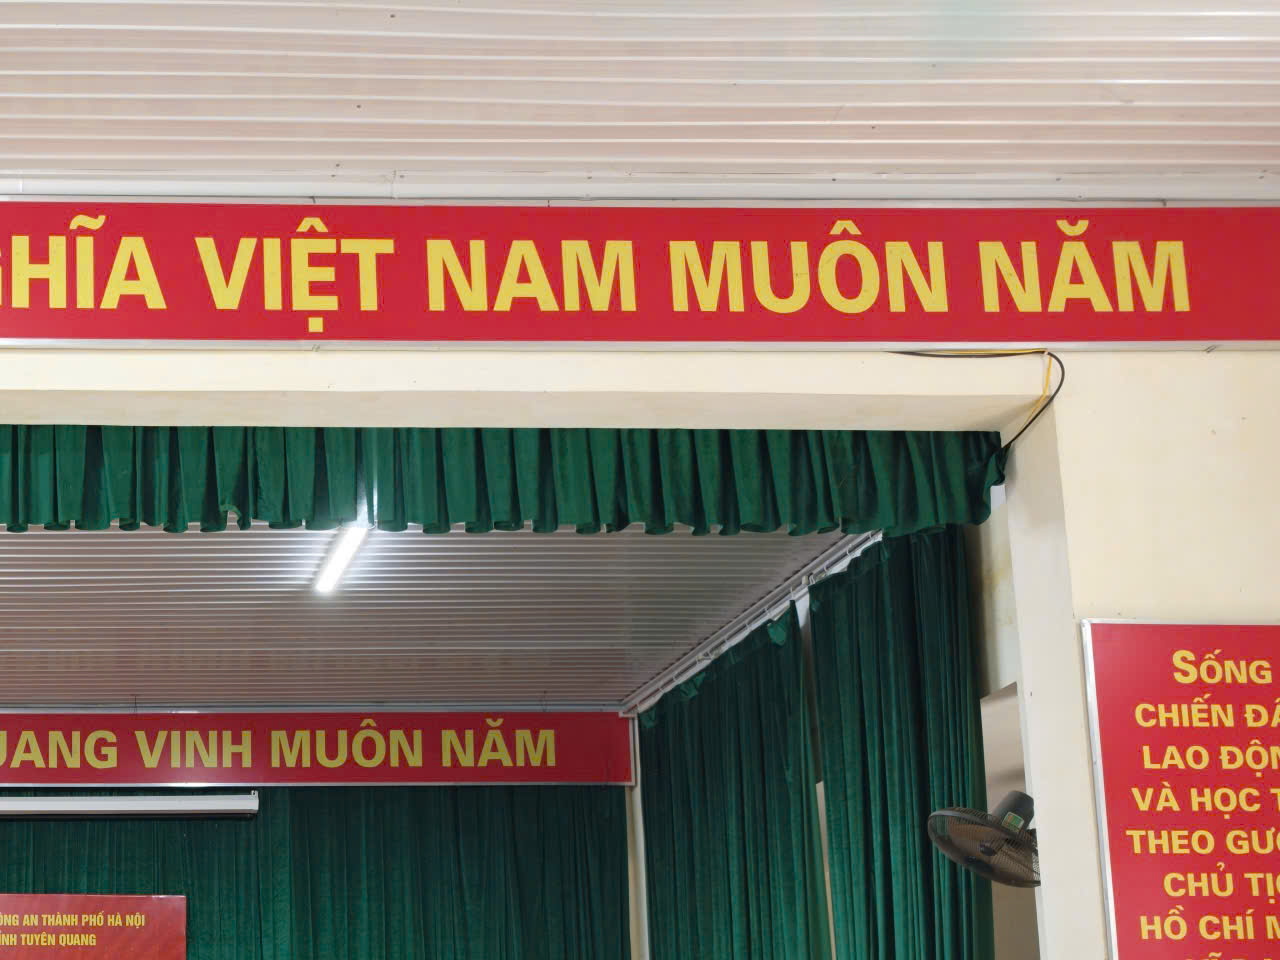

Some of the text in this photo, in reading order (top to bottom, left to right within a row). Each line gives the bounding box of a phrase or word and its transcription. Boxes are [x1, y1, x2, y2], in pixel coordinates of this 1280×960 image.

[195, 217, 396, 332] VIỆT
[426, 239, 638, 313] NAM
[669, 219, 950, 314] MUÔN
[978, 219, 1192, 313] NĂM
[1173, 649, 1273, 685] SỐNG
[1135, 692, 1235, 728] CHIẾN
[134, 729, 252, 769] VINH
[271, 719, 425, 769] MUÔN
[440, 719, 557, 769] NĂM
[1142, 744, 1210, 770] LAO
[1131, 782, 1180, 812] VÀ
[1190, 786, 1261, 819] HỌC
[1126, 829, 1215, 855] THEO
[1163, 862, 1234, 898] CHỦ
[22, 914, 39, 926] AN
[41, 912, 79, 927] THÀNH
[81, 910, 105, 927] PHỐ
[107, 912, 123, 927] HÀ
[125, 912, 145, 929] NỘI
[1140, 905, 1188, 940] HỒ
[1198, 908, 1256, 940] CHÍ
[20, 931, 57, 946] TUYÊN
[59, 933, 97, 947] QUANG
